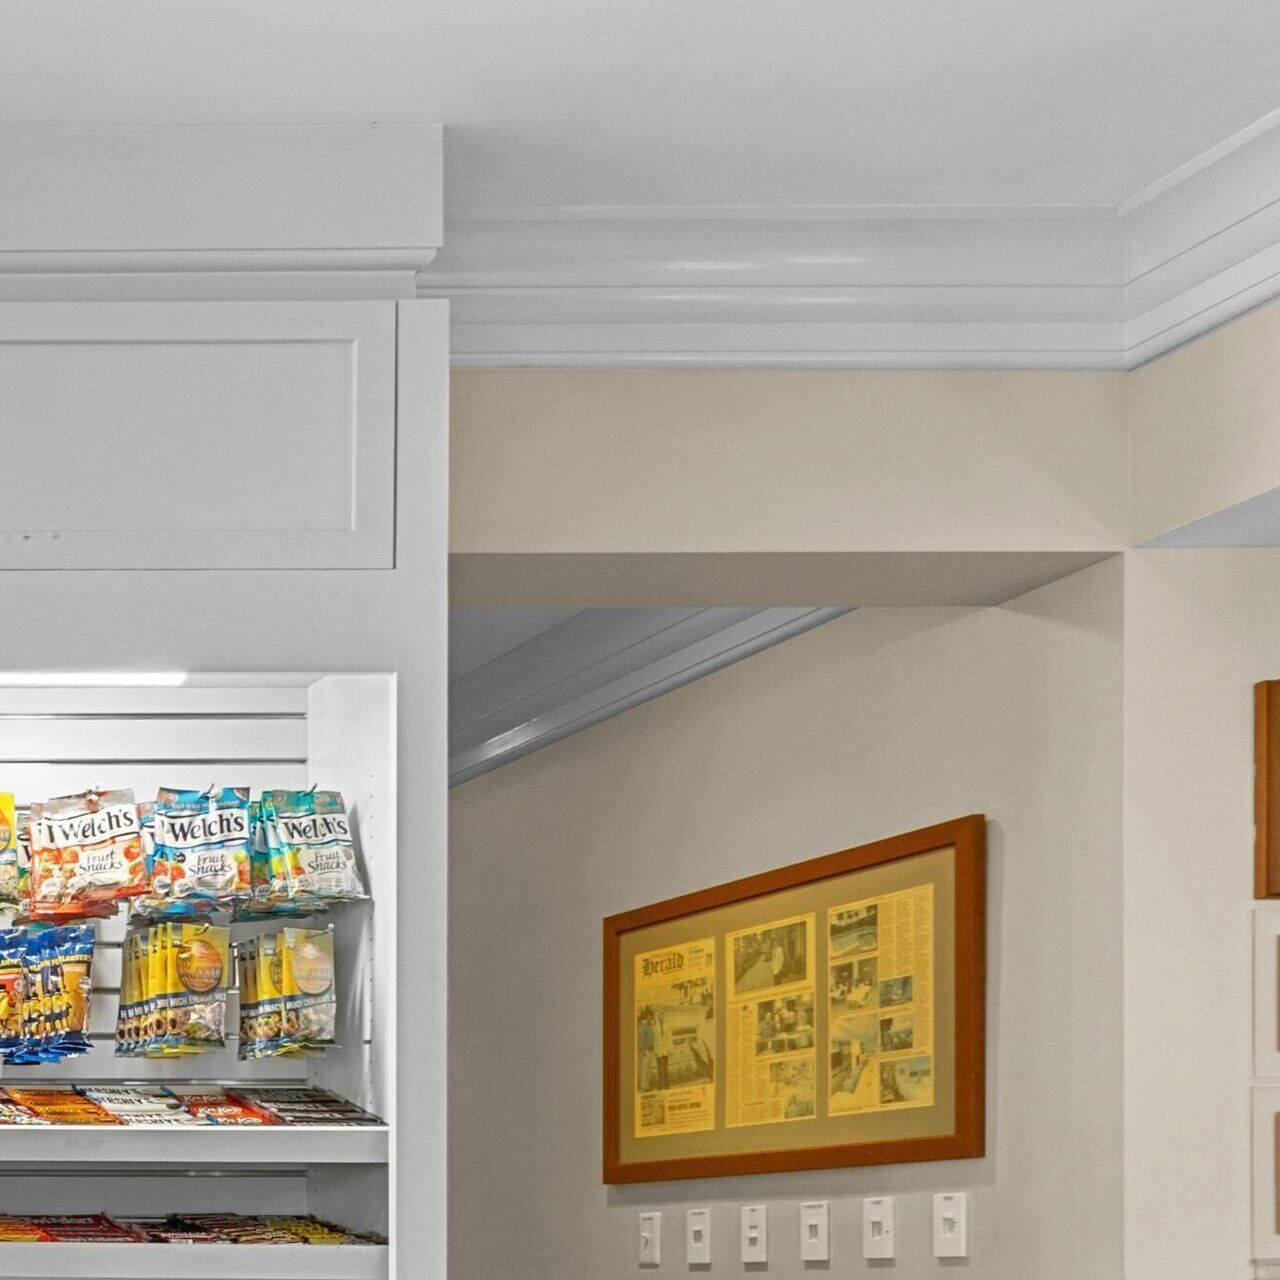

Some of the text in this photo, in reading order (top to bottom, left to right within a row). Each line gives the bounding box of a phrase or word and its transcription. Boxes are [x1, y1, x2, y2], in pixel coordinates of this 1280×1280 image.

[58, 810, 134, 841] Welch's
[169, 813, 246, 842] Welch's
[284, 817, 349, 841] Welch's
[78, 859, 124, 875] Snacks
[189, 862, 233, 877] Snacks
[641, 953, 684, 976] Herald
